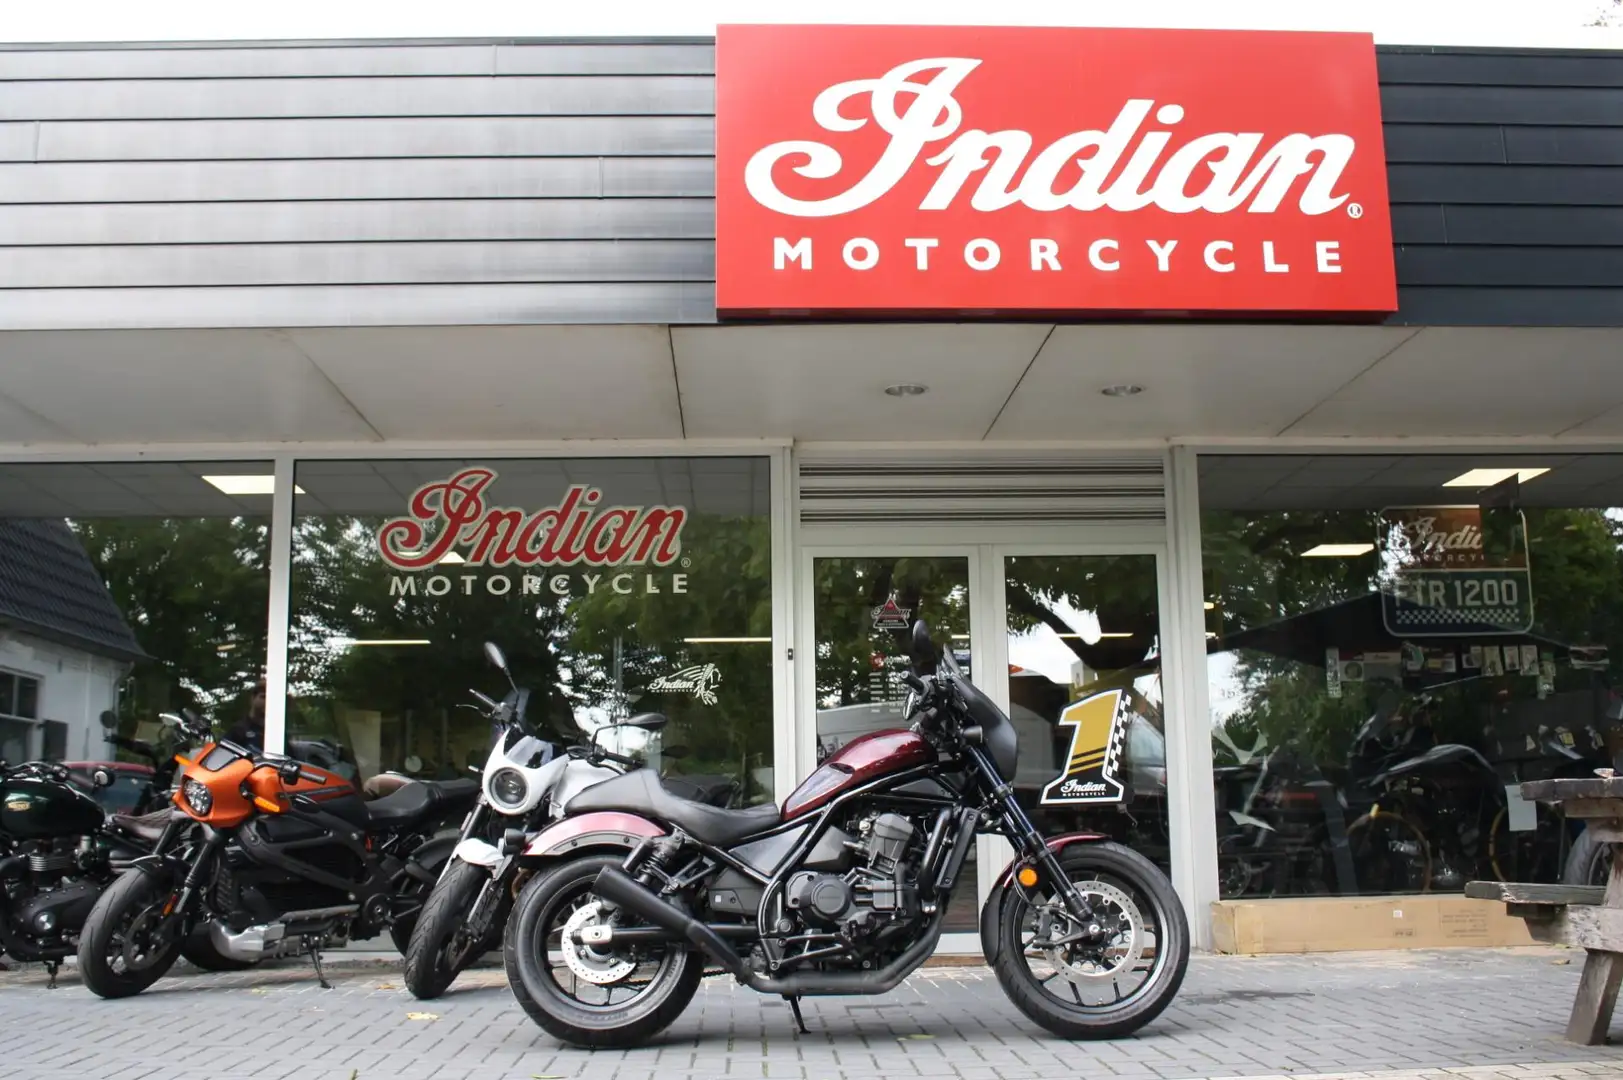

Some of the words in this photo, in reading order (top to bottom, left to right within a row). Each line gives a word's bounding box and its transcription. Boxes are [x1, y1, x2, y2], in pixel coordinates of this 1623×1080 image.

[744, 57, 1356, 216] Indian
[773, 236, 1342, 273] MOTORCYCLE
[377, 466, 688, 571] Indian
[389, 573, 688, 596] MOTORCYCLE
[1396, 579, 1447, 607] FTR
[1454, 579, 1518, 606] 1200
[648, 676, 695, 689] Indian
[1061, 779, 1106, 793] Indian
